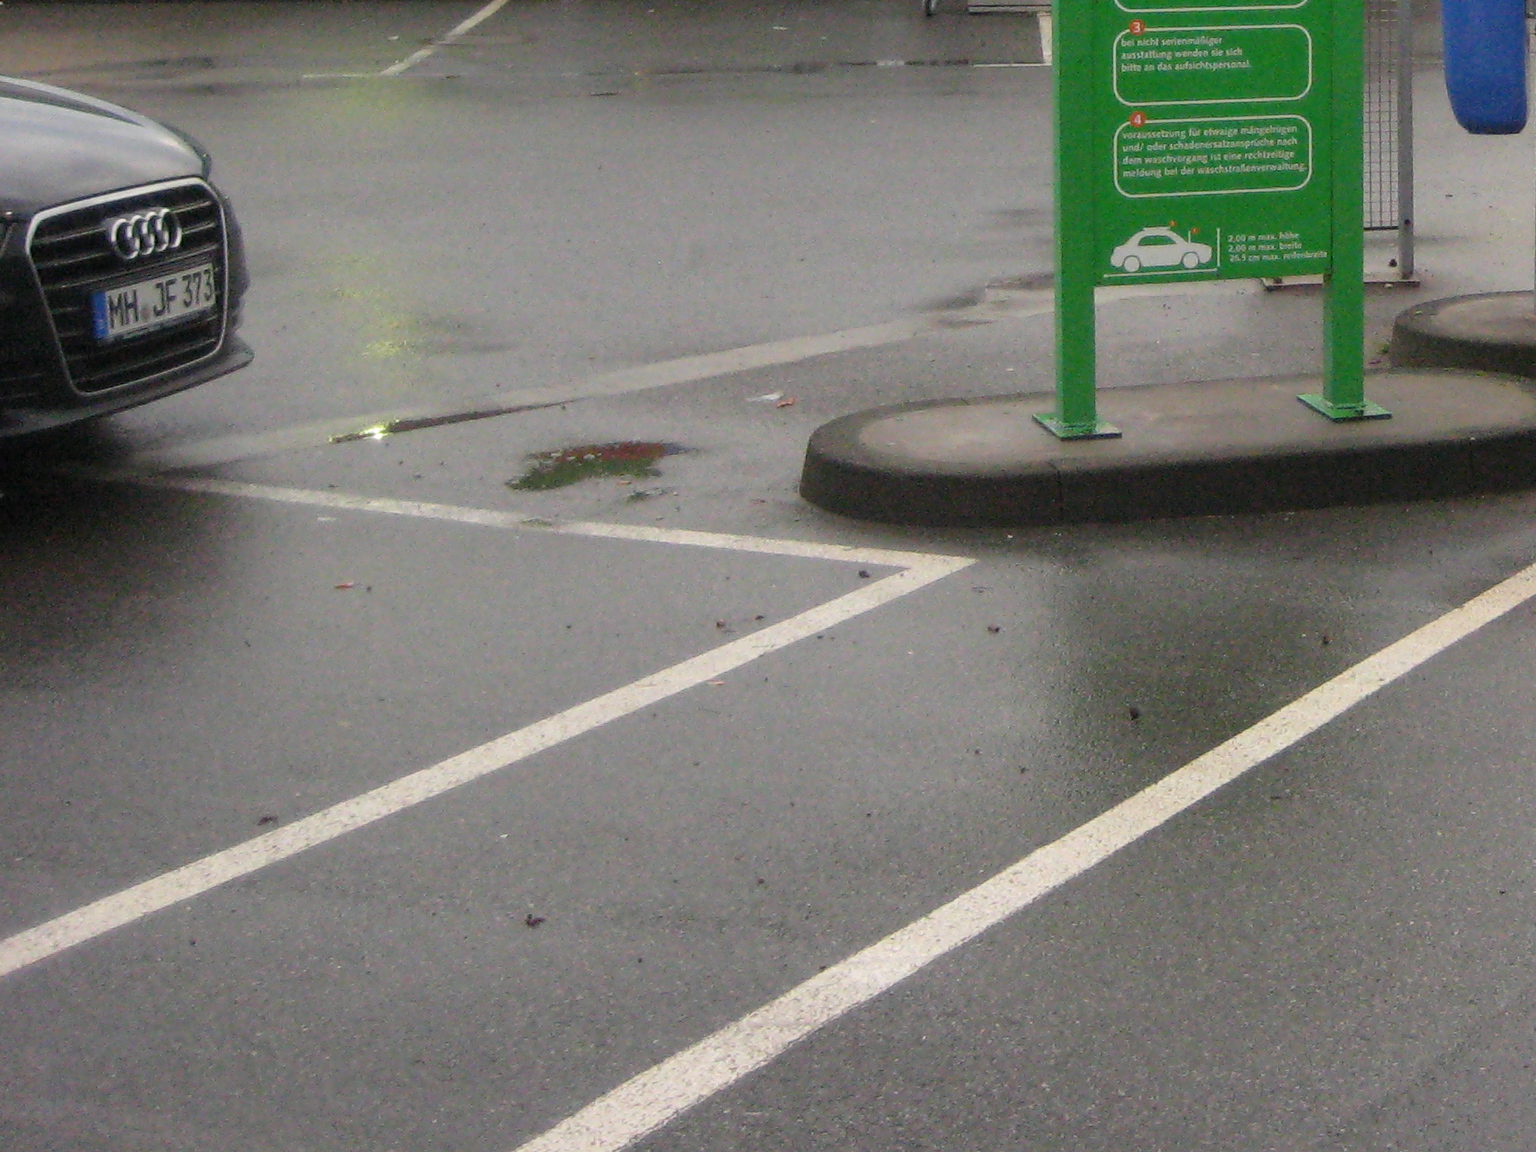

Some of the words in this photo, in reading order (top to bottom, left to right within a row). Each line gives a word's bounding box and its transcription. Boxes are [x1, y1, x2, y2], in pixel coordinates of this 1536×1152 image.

[1121, 38, 1136, 47] bei
[1137, 38, 1159, 47] nicht
[1121, 50, 1173, 61] ausstattung
[1174, 49, 1209, 58] wenden
[1211, 48, 1224, 57] sie
[1225, 47, 1243, 56] sich
[1121, 63, 1142, 72] bitte
[1144, 64, 1155, 72] an
[1157, 62, 1173, 71] das
[1122, 129, 1187, 139] voraussetzung
[1203, 126, 1239, 138] etwaige
[1146, 141, 1167, 151] oder
[1276, 137, 1299, 146] nach
[1122, 155, 1143, 165] dem
[1223, 152, 1243, 161] eine
[1122, 167, 1163, 179] meldung
[1164, 166, 1178, 176] bei
[1180, 165, 1196, 175] der
[108, 289, 139, 329] MH
[153, 278, 178, 316] JF
[182, 268, 214, 308] 373
